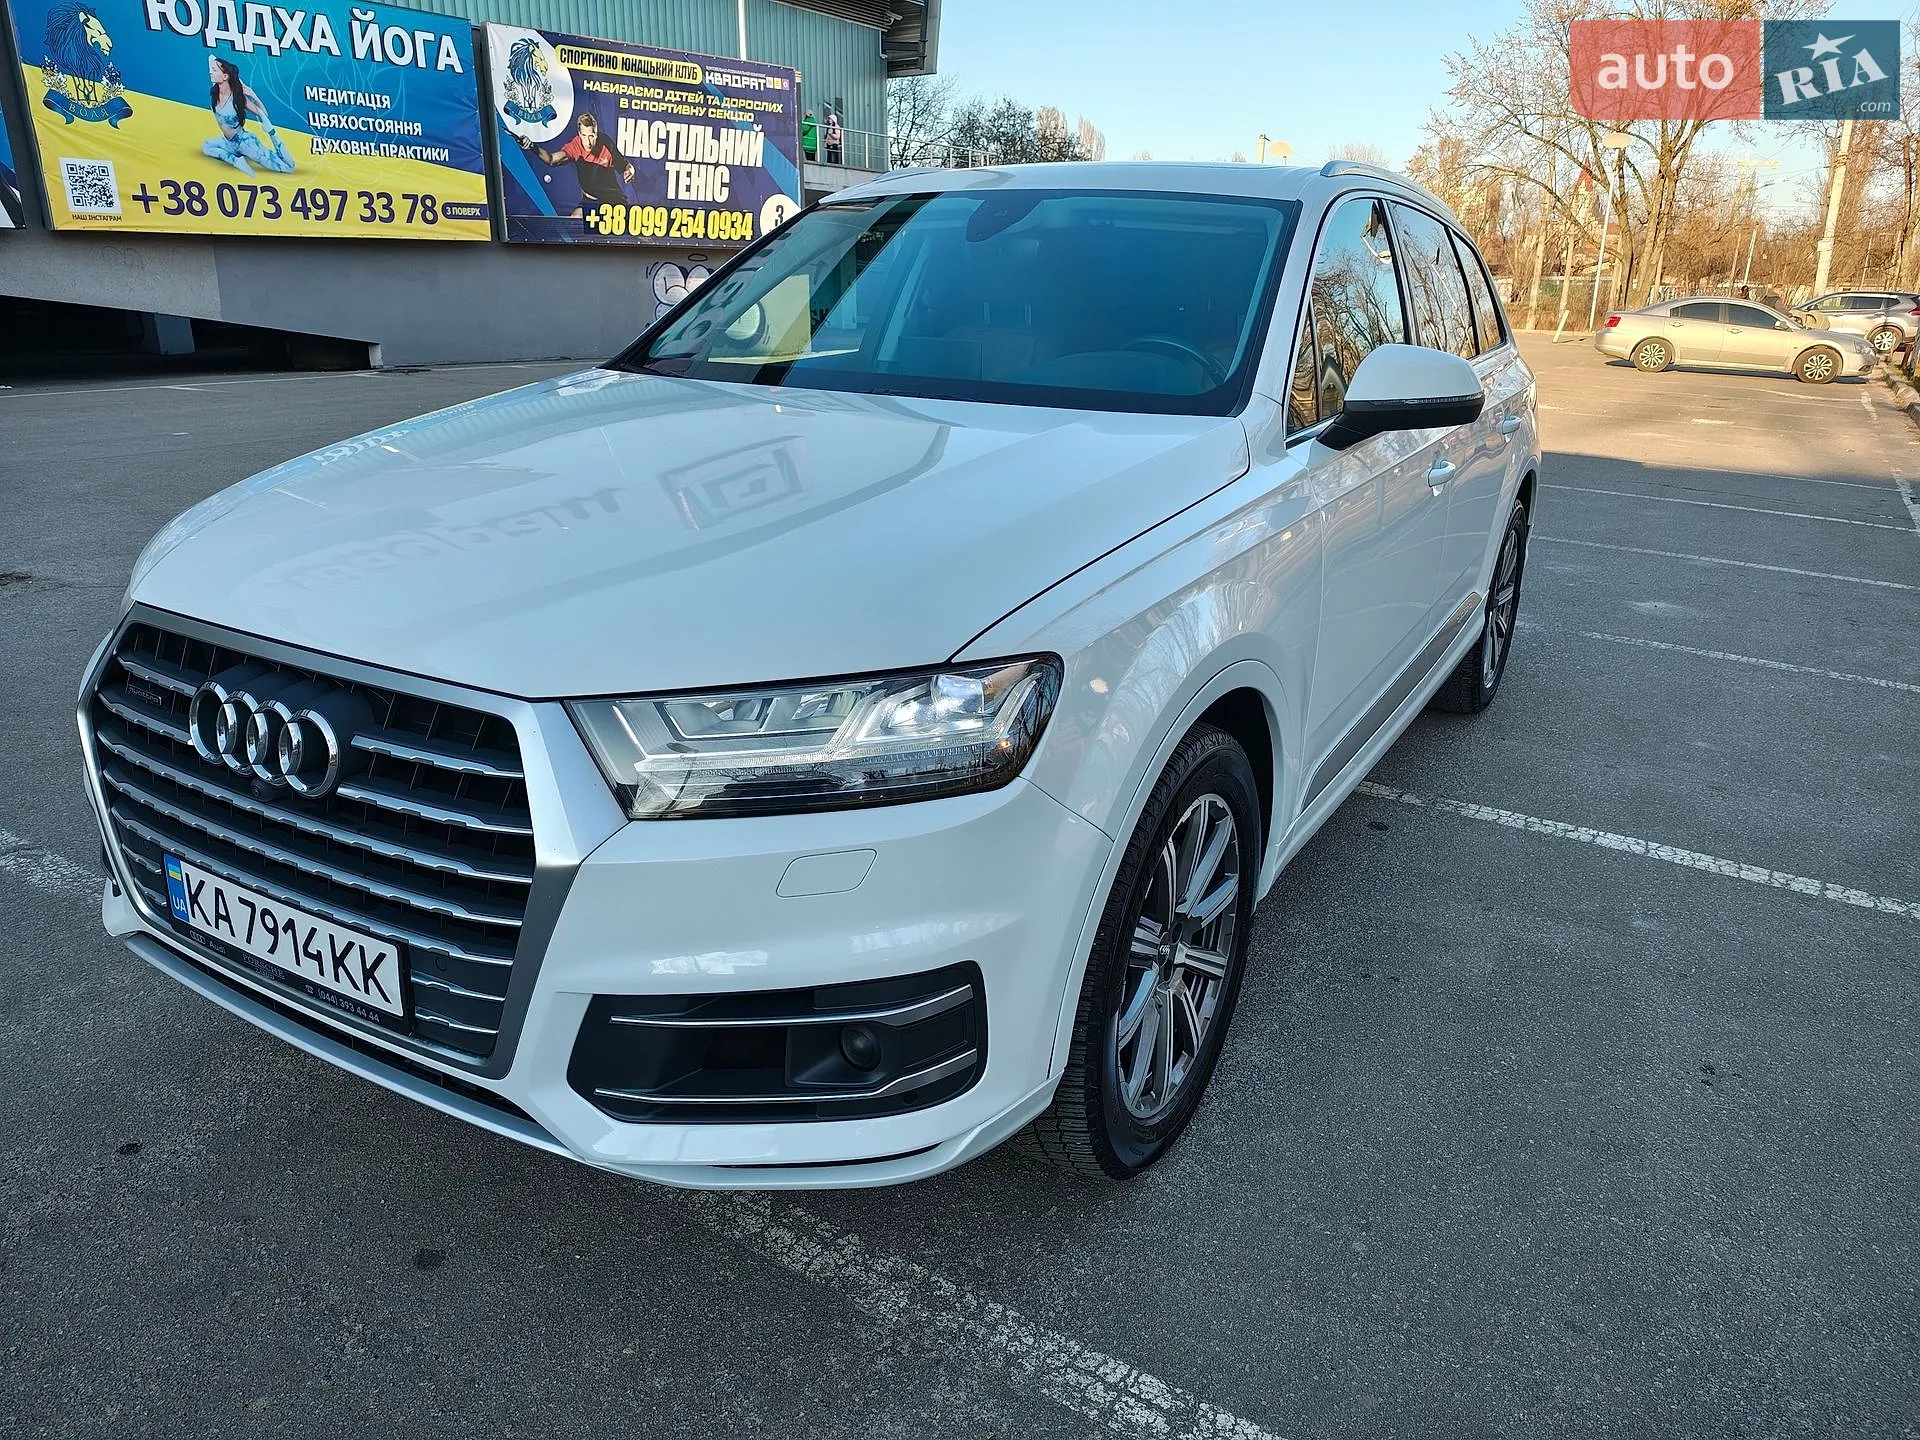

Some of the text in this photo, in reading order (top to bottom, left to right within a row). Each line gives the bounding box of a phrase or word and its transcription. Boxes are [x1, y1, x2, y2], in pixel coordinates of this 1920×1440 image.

[145, 0, 464, 73] ЮДДХА ЙОГА
[560, 47, 618, 70] СПОРТИВНО
[621, 56, 674, 77] ЮНАЦЬКИЙ
[675, 64, 698, 81] КЛУБ
[705, 71, 766, 91] КВАДРАТ
[305, 85, 391, 110] МЕДИТАЦІЯ
[583, 79, 784, 113] НАБИРАЄМО ДІТЕЙ ТА ДОРОСЛИХ
[69, 103, 109, 119] ВОЛЯ
[619, 98, 755, 123] В СПОРТИВНУ СЕКЦІЮ
[308, 112, 423, 136] ЦВЯХОСТОЯННЯ
[312, 137, 450, 162] ДУХОВНІ ПРАКТИКИ
[616, 117, 765, 168] НАСТІЛЬНИЙ
[665, 161, 730, 203] ТЕНІС
[132, 179, 439, 225] +38 073 497 33 78
[452, 206, 482, 217] ПОВЕРХ
[585, 203, 753, 241] +38 099 254 0934
[775, 204, 784, 227] 3
[173, 895, 188, 915] UA
[209, 940, 227, 955] Audi
[242, 953, 286, 979] PORSCHE
[318, 986, 380, 1023] (044) 393 44 44
